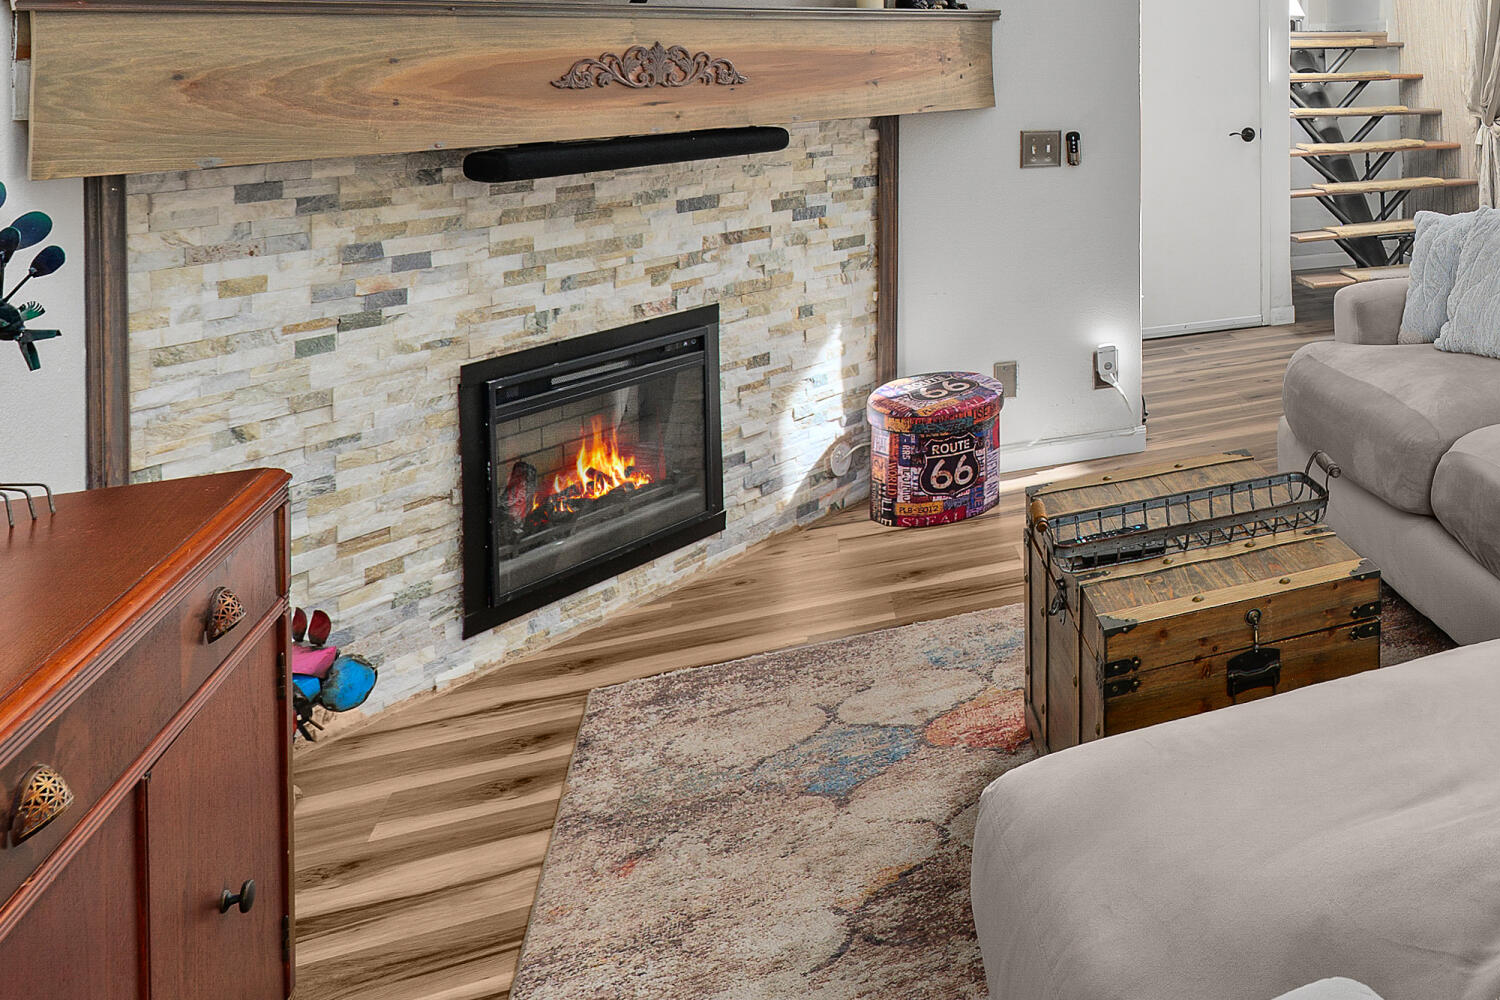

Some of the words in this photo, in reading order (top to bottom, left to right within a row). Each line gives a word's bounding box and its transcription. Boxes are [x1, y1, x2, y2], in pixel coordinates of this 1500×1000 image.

[920, 380, 971, 399] 66
[931, 438, 970, 455] ROUTE
[931, 454, 973, 490] 66
